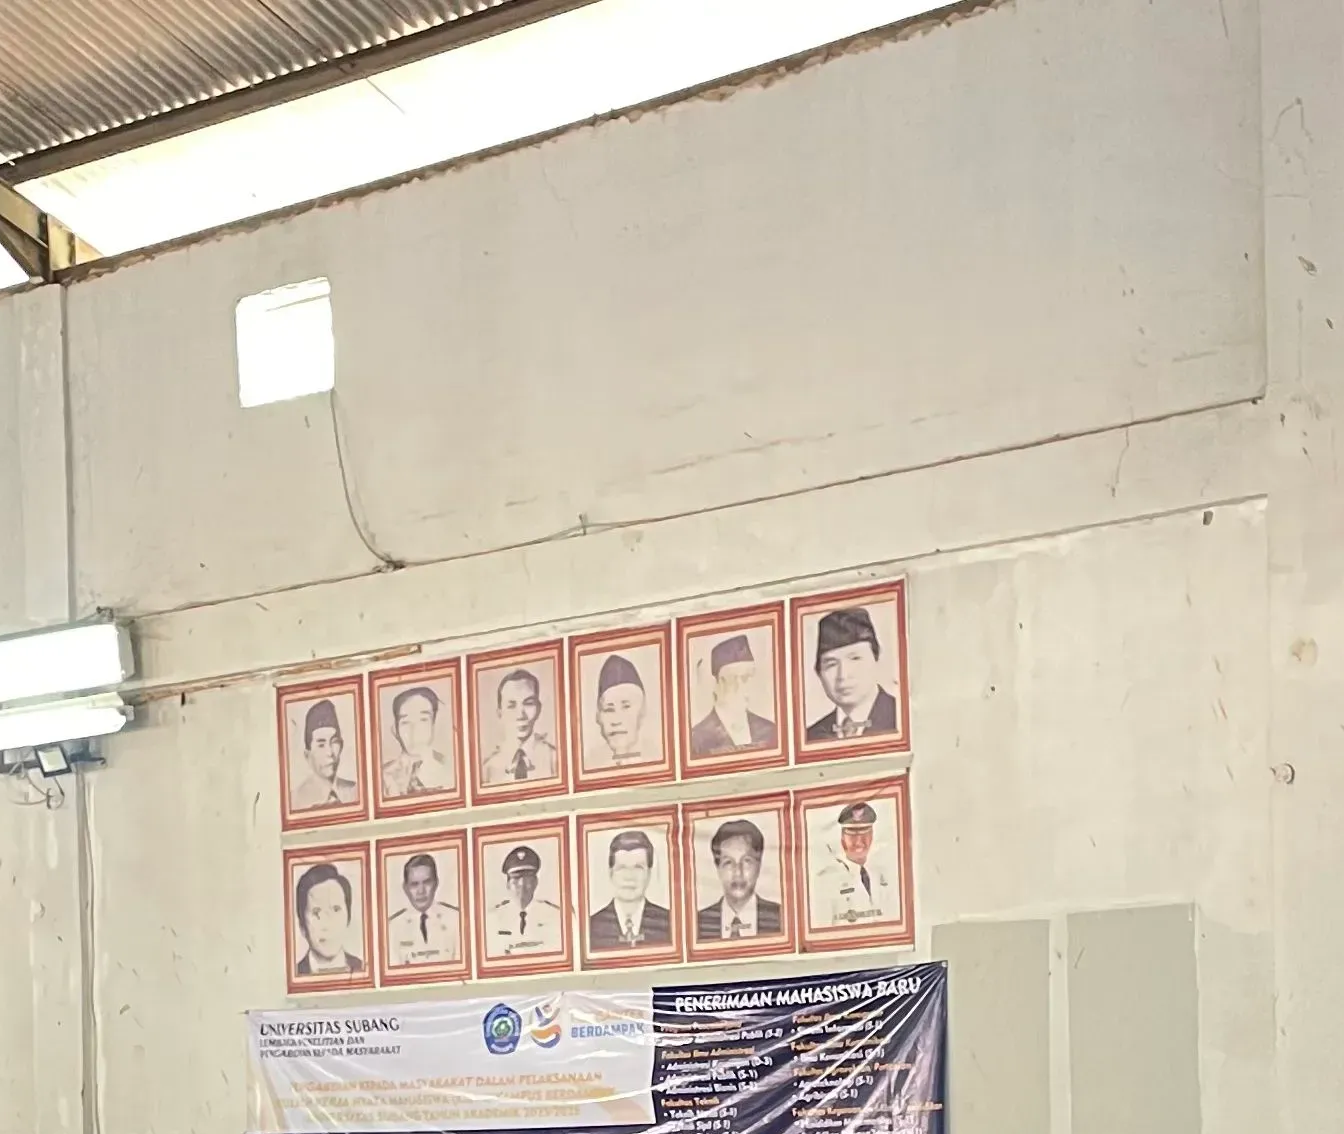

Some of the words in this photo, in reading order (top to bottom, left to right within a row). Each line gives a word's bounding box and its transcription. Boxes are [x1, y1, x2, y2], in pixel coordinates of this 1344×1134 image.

[675, 992, 773, 1013] PENERIMAAN
[776, 982, 873, 1007] MAHASISWA
[876, 976, 922, 998] BARU
[260, 1021, 341, 1036] UNIVERSITAS
[345, 1017, 400, 1034] SUBANG
[571, 1022, 645, 1039] BERDAMPAK
